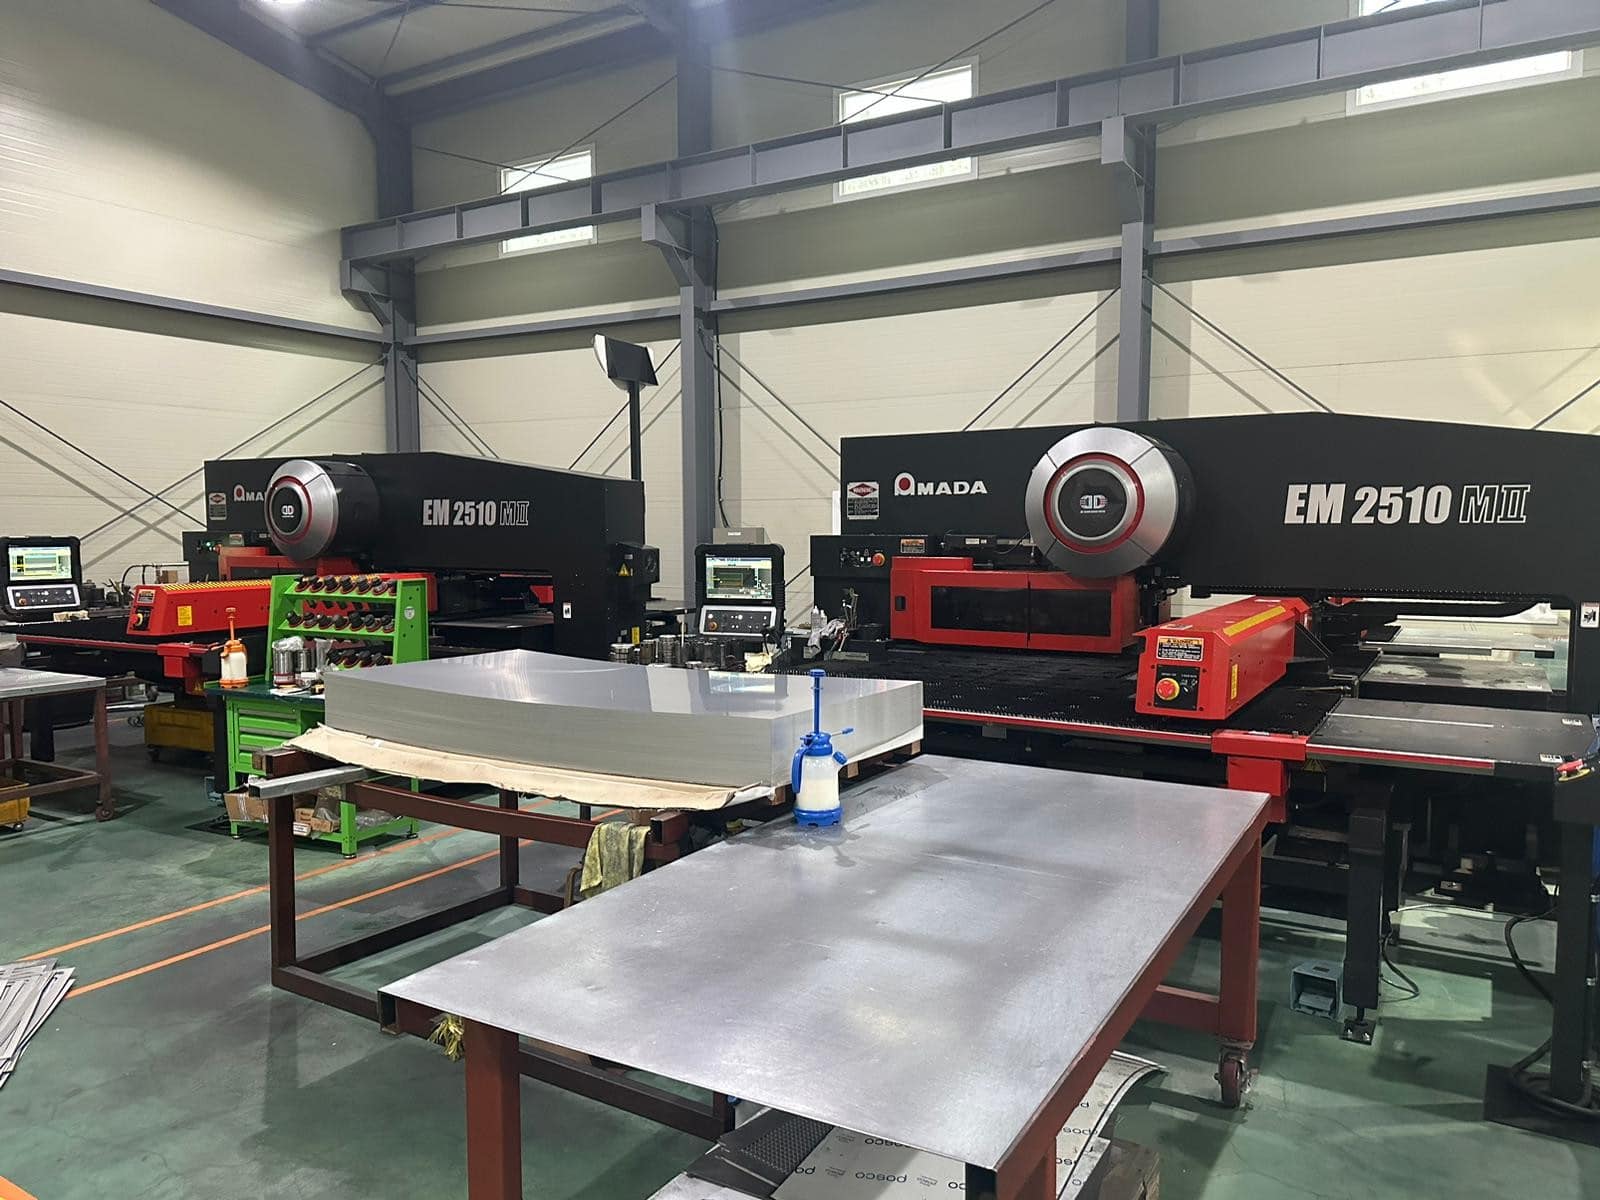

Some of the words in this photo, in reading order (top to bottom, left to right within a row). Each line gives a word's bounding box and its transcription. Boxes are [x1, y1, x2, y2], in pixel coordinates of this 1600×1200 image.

[894, 472, 988, 496] AMADA
[422, 499, 450, 526] EM
[453, 500, 497, 526] 2510
[1283, 483, 1346, 524] EM
[1351, 485, 1453, 525] 2510
[855, 1171, 907, 1183] posco
